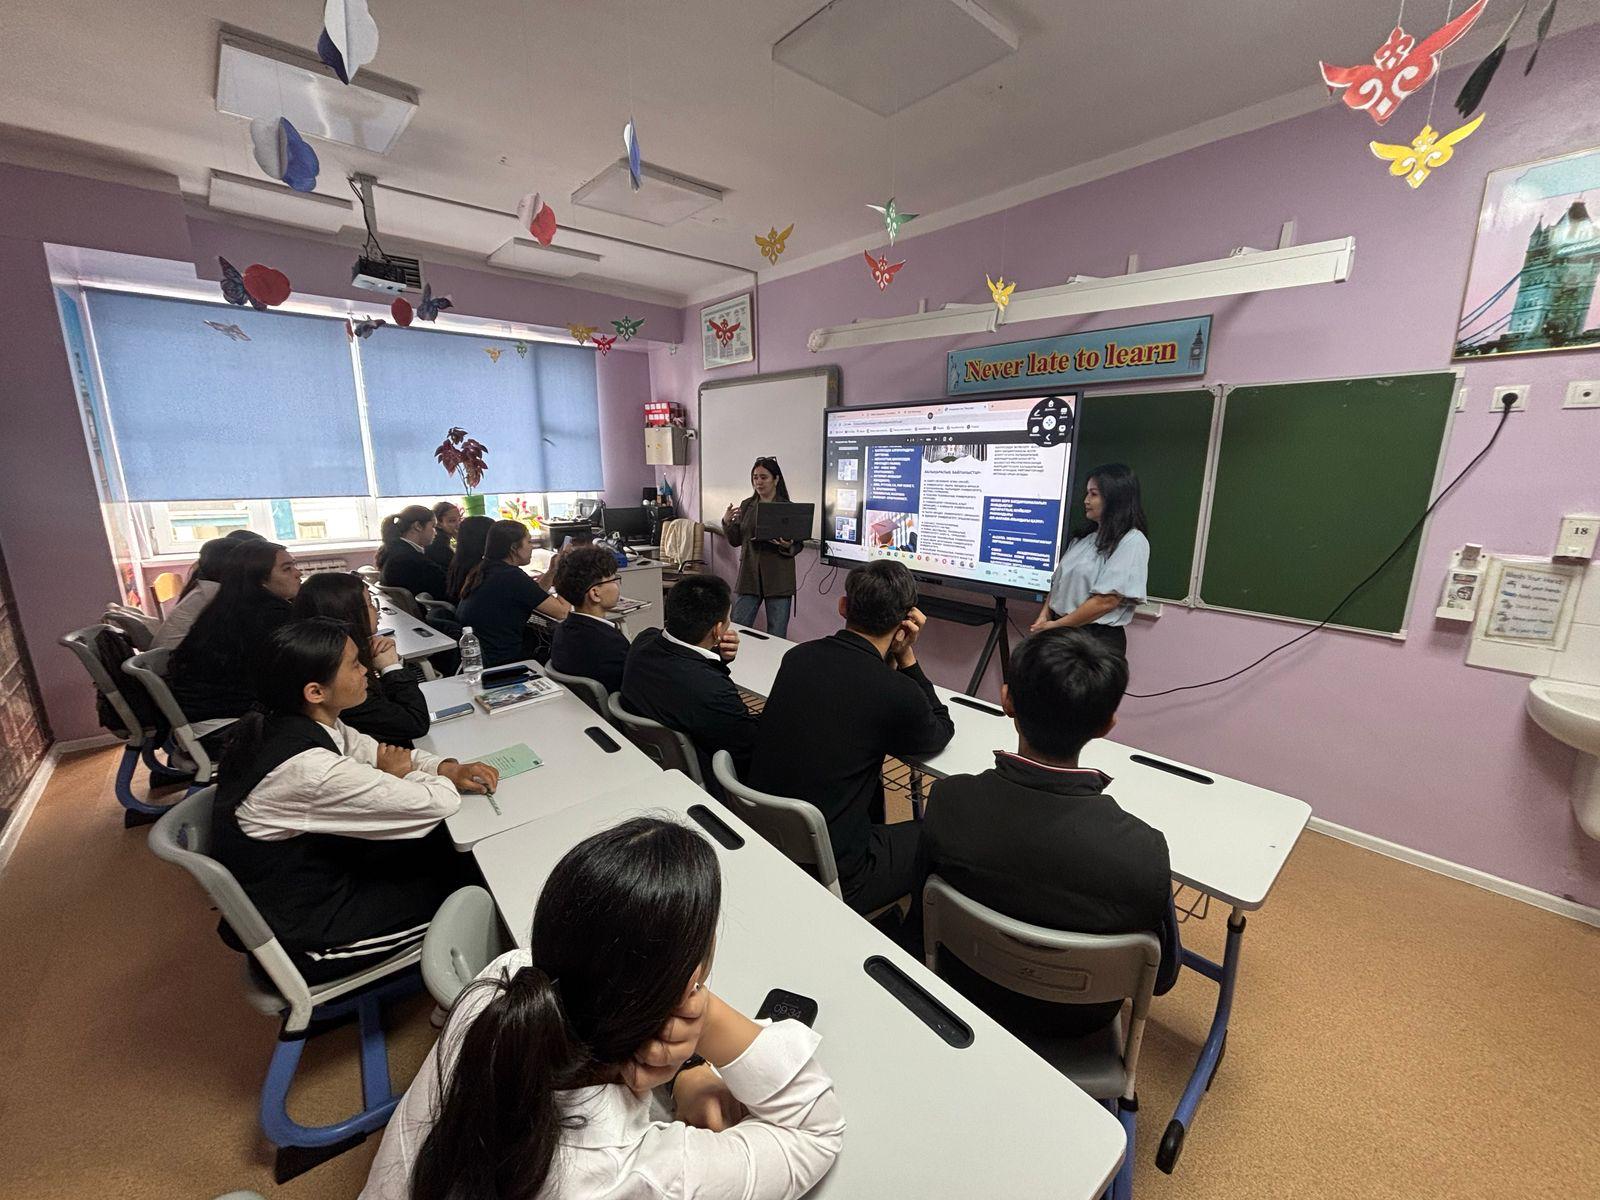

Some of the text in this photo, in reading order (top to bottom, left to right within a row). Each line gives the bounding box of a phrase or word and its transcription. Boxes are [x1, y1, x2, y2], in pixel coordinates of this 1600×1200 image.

[964, 340, 1178, 382] Never late to learn
[1573, 527, 1588, 535] 18
